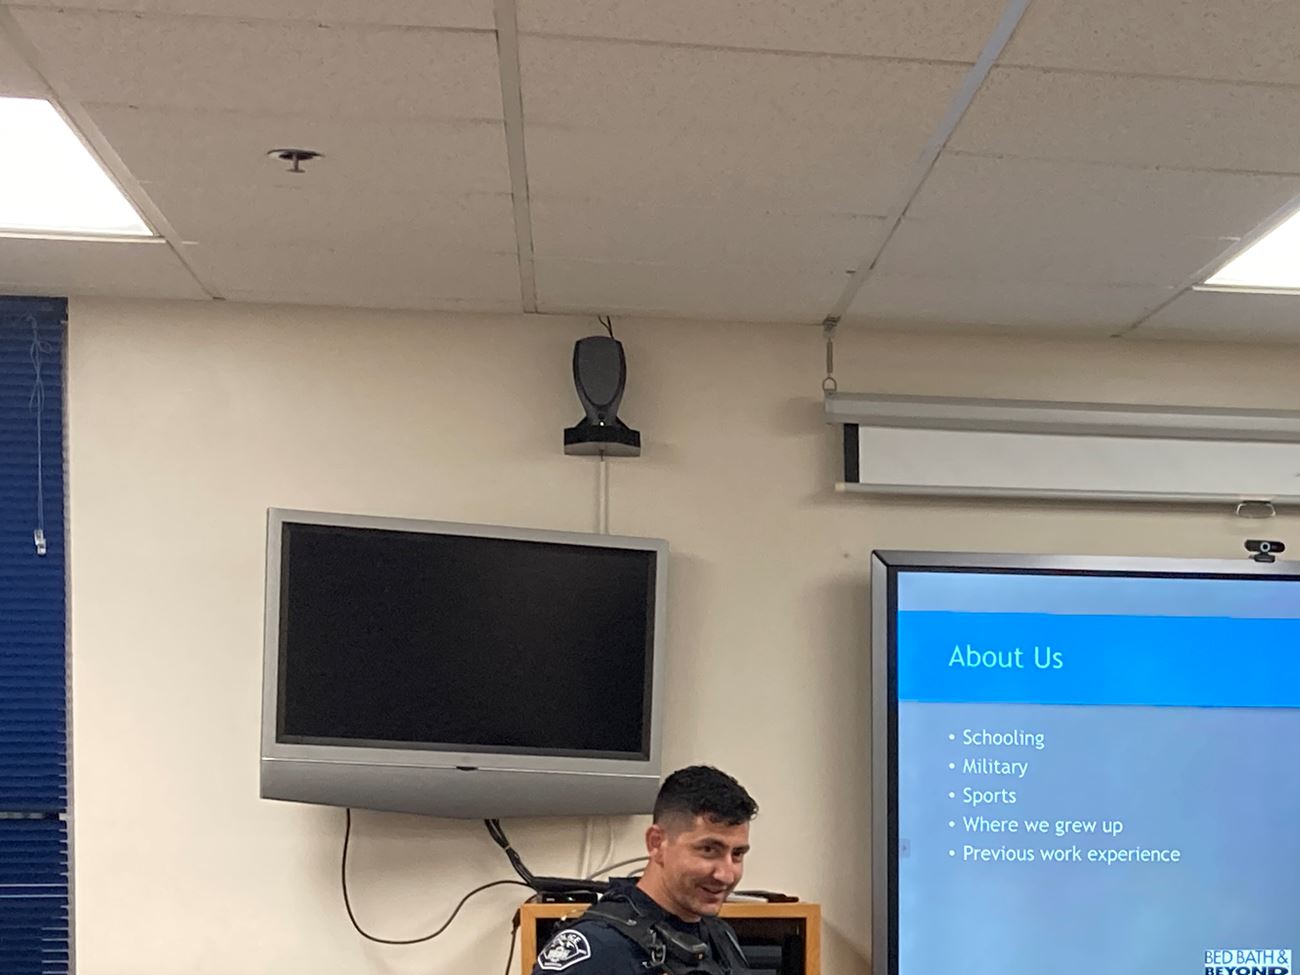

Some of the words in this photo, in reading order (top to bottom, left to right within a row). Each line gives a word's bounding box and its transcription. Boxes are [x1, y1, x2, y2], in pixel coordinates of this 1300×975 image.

[948, 644, 1025, 669] About
[1034, 646, 1064, 669] Us
[962, 729, 1045, 750] Schooling
[962, 758, 1029, 778] Military
[962, 787, 1017, 807] Sports
[962, 816, 1019, 833] Where
[1024, 819, 1050, 833] we
[1055, 819, 1097, 836] grew
[1102, 820, 1124, 837] up
[962, 844, 1035, 862] Previous
[1040, 845, 1082, 862] work
[1087, 846, 1181, 865] experience
[1204, 950, 1233, 965] BED
[1236, 950, 1274, 965] BATH
